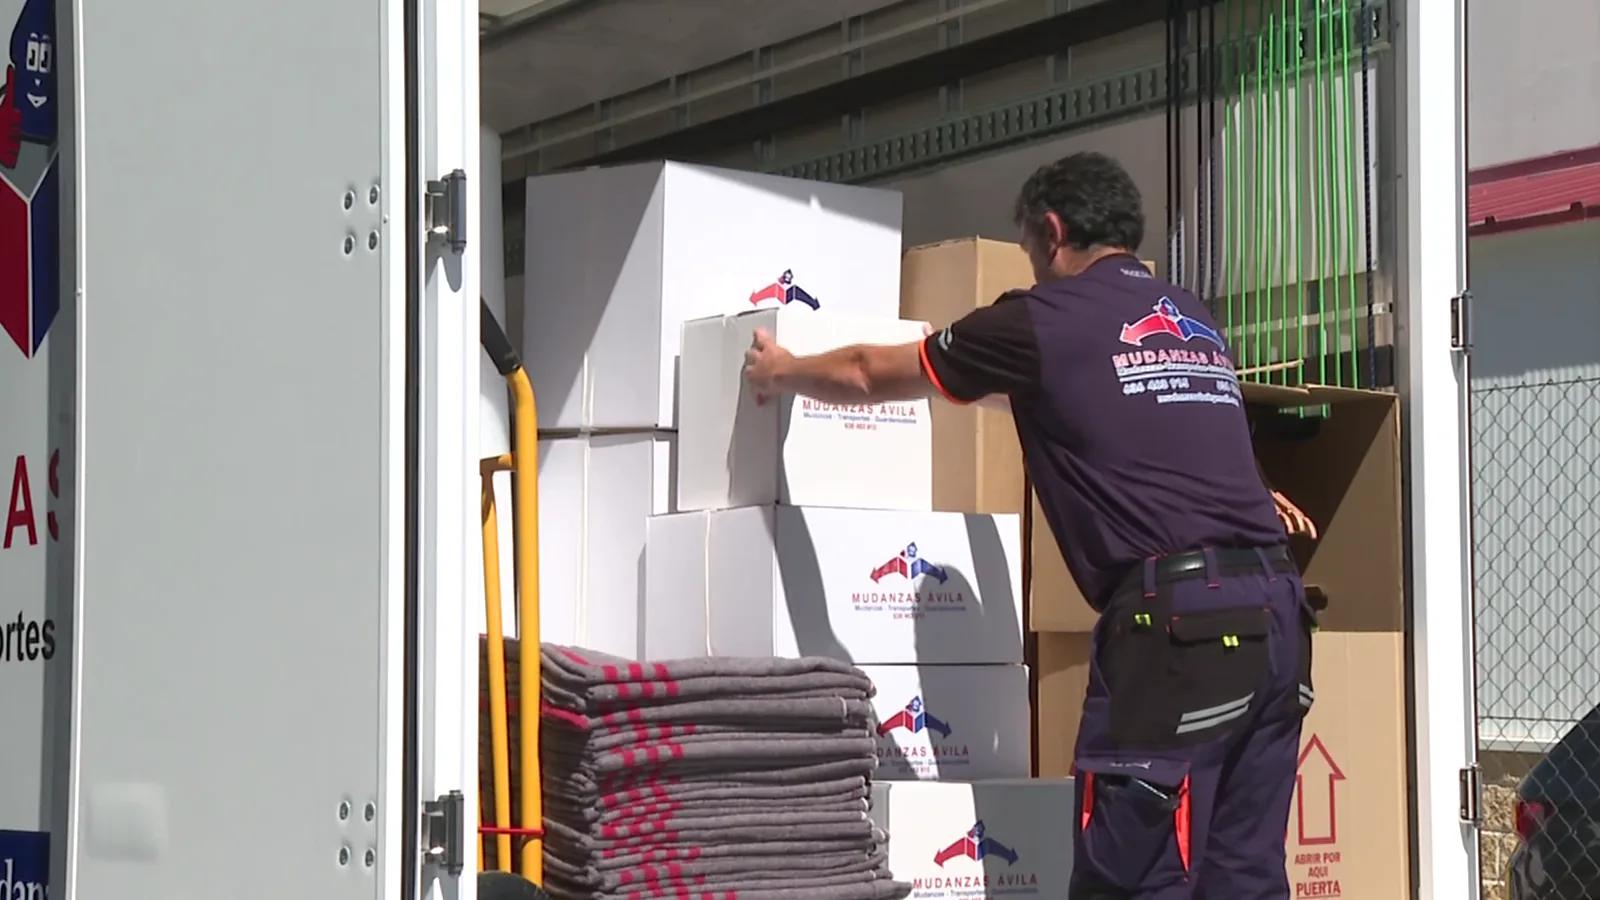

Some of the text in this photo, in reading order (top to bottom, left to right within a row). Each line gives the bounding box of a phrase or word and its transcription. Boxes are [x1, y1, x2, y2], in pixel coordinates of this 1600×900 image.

[803, 400, 874, 415] MUDANZAS
[852, 592, 921, 604] MUDANZAS
[0, 609, 56, 662] rtes
[1295, 852, 1341, 865] ABRIR POR
[913, 876, 990, 889] MUDANZAS
[1296, 880, 1341, 896] PUERTA
